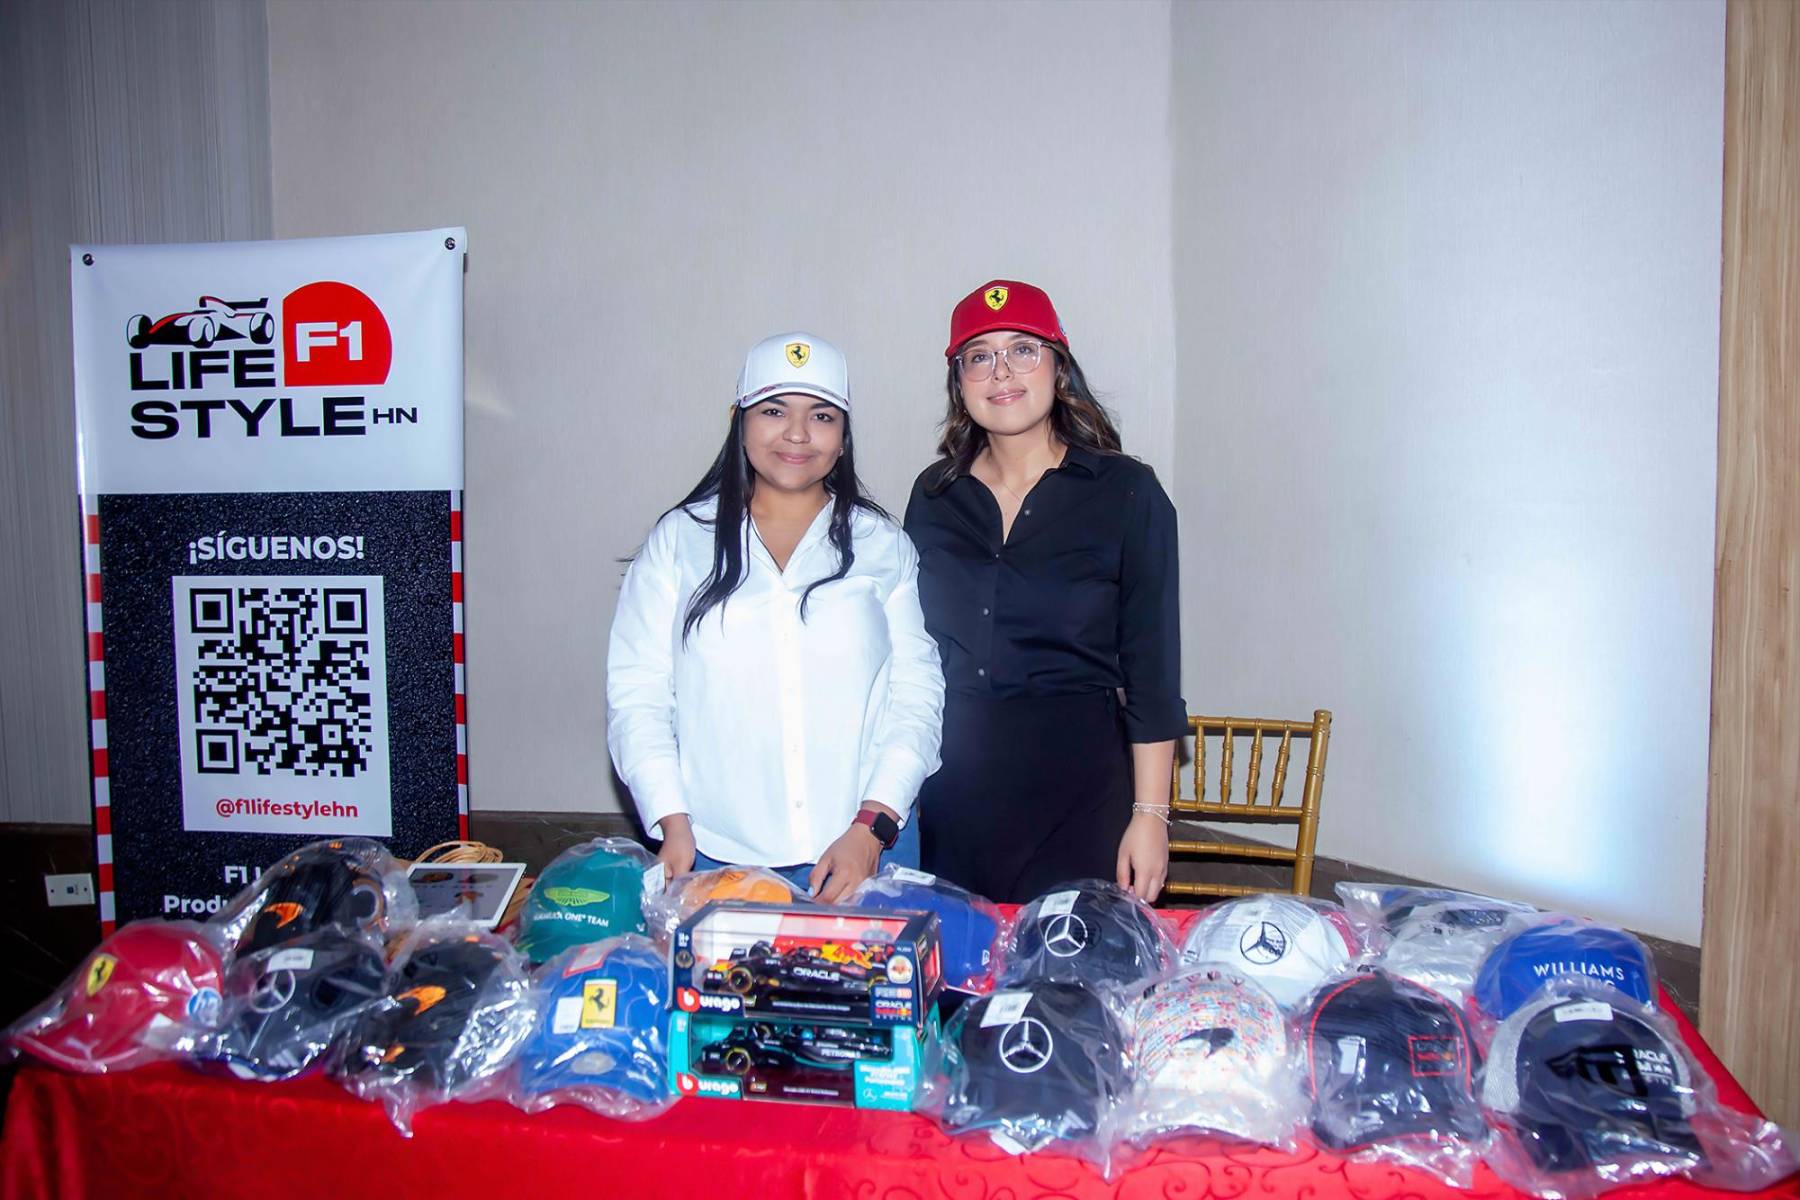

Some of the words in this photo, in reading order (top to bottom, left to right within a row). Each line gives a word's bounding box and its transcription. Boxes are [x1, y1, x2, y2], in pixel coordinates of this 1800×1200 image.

[296, 320, 363, 362] F1
[129, 349, 276, 390] LIFE
[131, 396, 366, 439] STYLE
[372, 407, 418, 425] HN
[189, 531, 365, 564] ¡SÍGUENOS!
[216, 798, 359, 819] @f1lifestylehn
[224, 865, 248, 884] F1
[164, 895, 228, 914] Prod
[587, 915, 609, 927] TEAM
[793, 967, 840, 982] ORACLE
[1533, 961, 1625, 981] WILLIAMS
